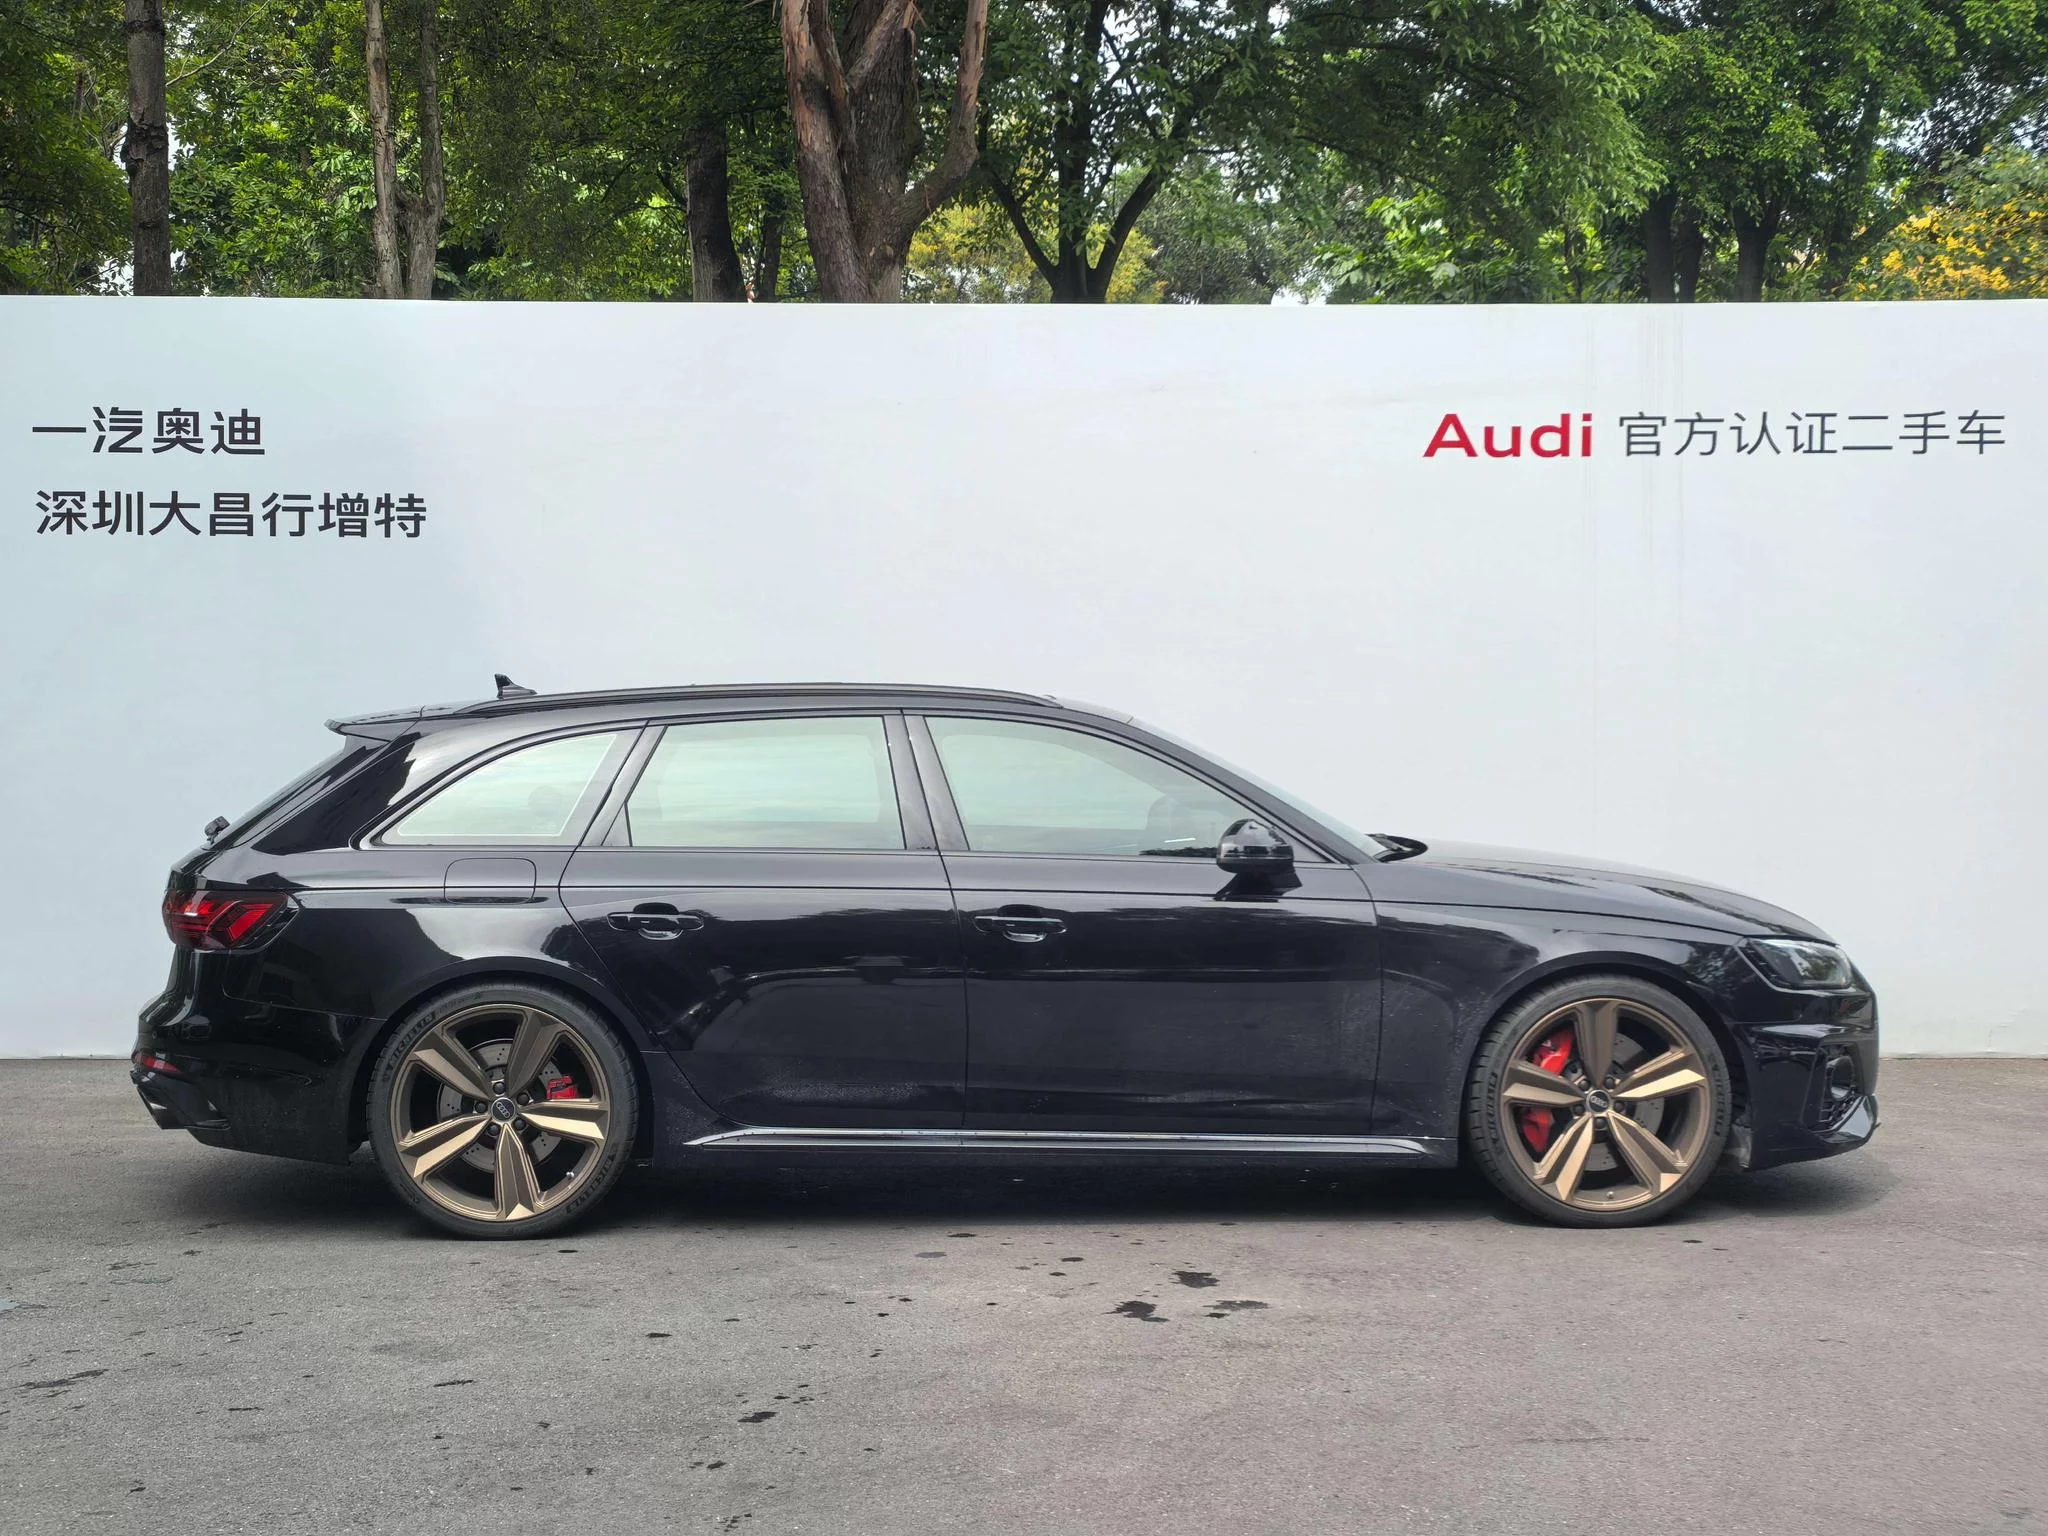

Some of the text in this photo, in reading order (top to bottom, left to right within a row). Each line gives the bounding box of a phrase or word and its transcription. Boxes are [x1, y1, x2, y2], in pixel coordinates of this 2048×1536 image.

[31, 406, 266, 455] 一汽奥迪
[1423, 409, 2007, 457] Audi 官方认证二手车
[35, 489, 427, 538] 深圳大昌行增特
